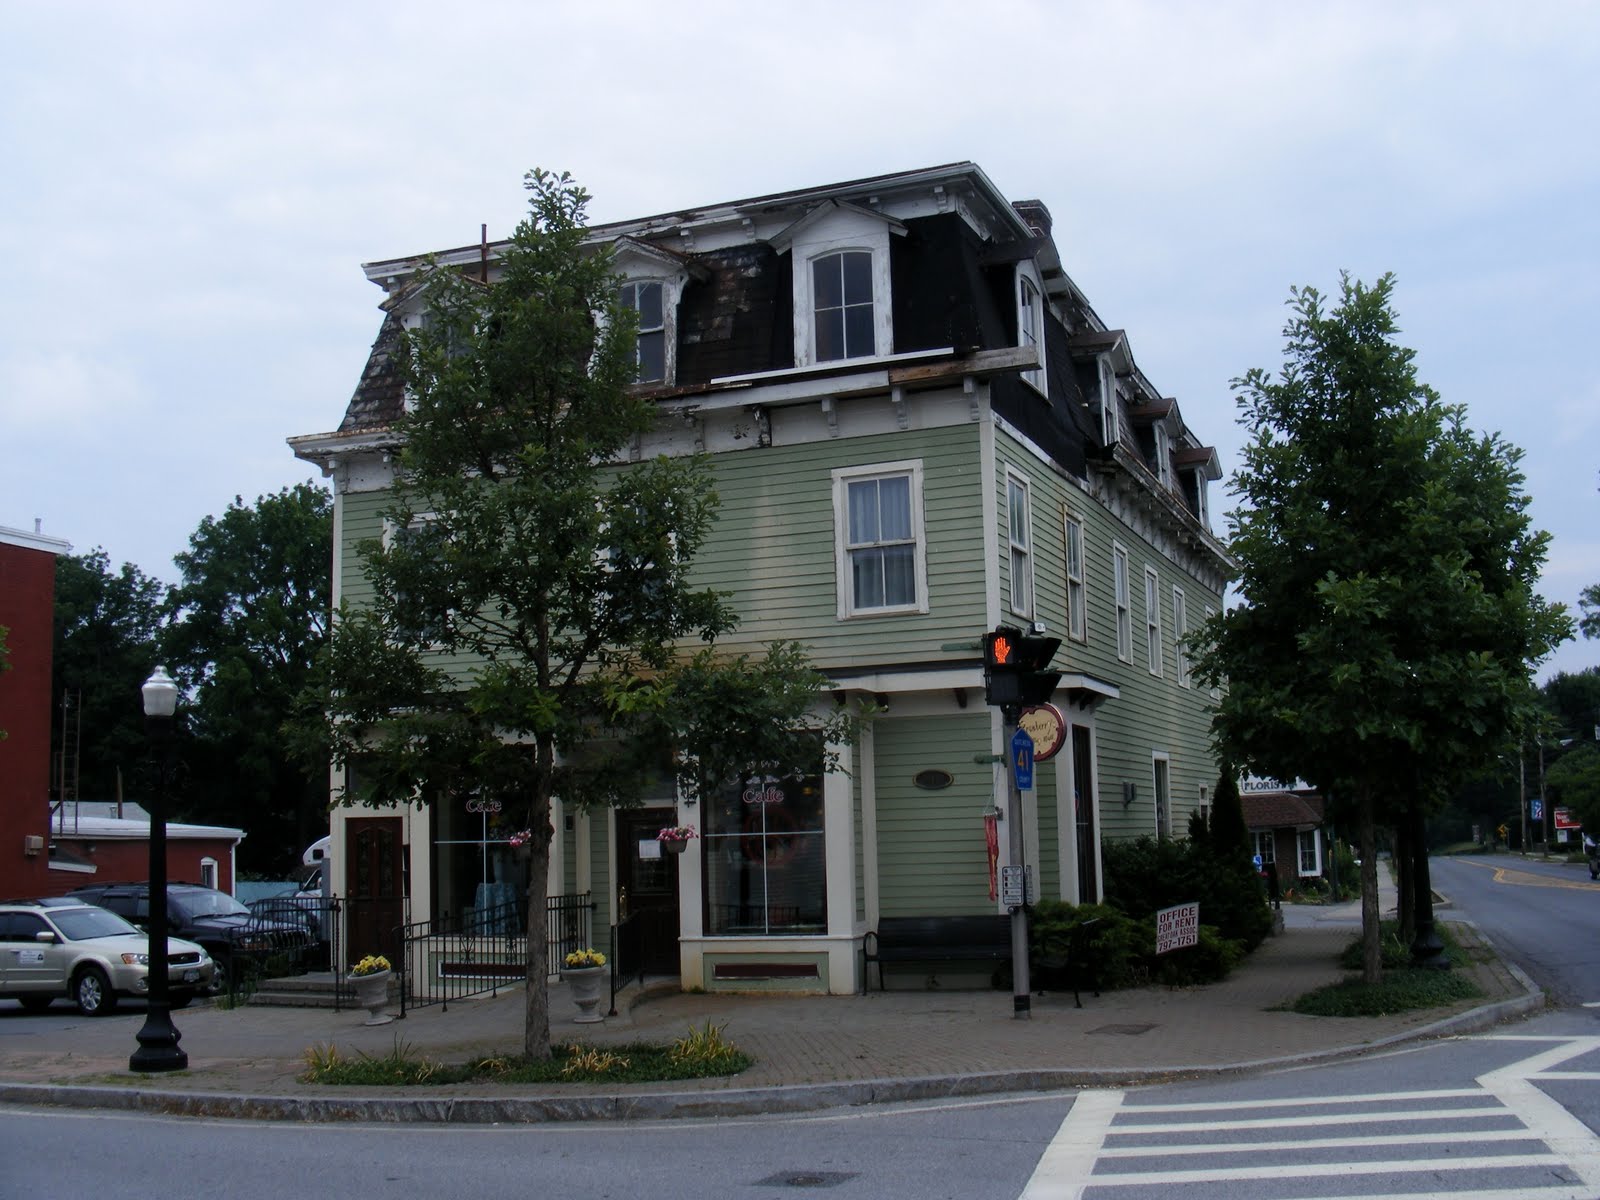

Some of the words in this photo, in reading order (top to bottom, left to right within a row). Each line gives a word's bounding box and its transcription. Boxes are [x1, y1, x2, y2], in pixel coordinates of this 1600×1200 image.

[1017, 749, 1029, 772] 41
[1244, 781, 1286, 791] FLORIS
[1160, 906, 1196, 923] OFFICE
[1158, 922, 1172, 934] FOR
[1175, 916, 1196, 929] RENT
[1158, 935, 1196, 952] 797-1751
